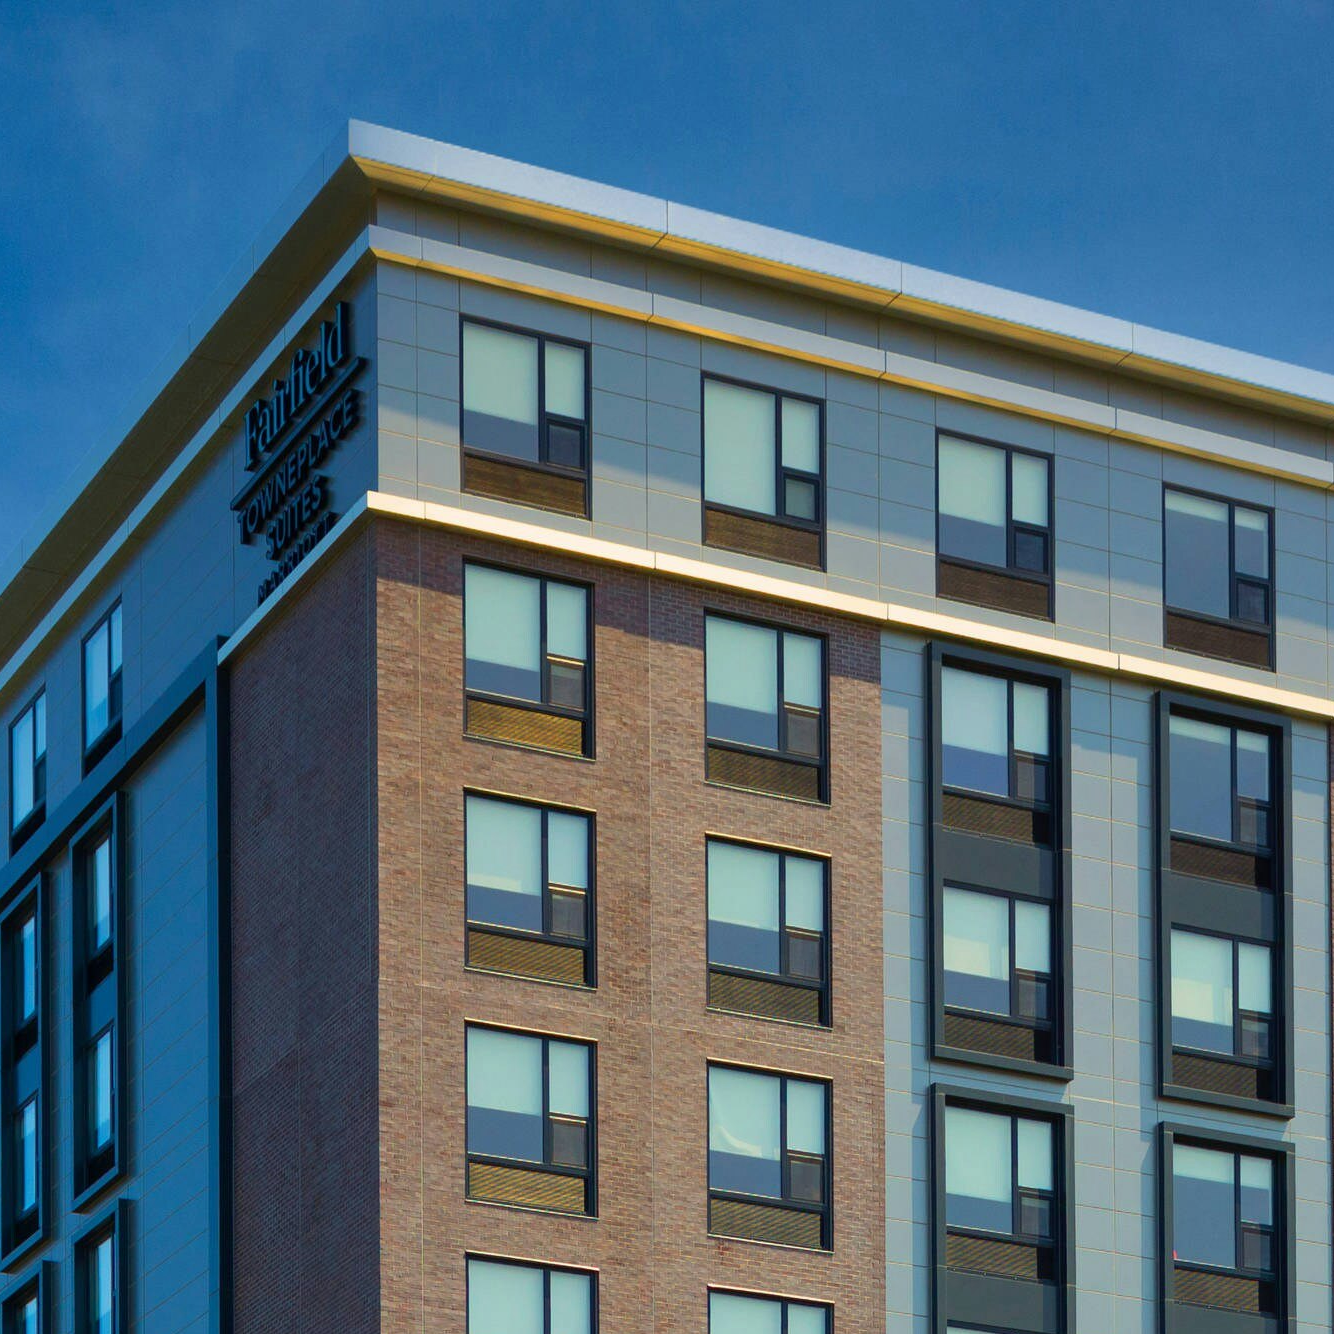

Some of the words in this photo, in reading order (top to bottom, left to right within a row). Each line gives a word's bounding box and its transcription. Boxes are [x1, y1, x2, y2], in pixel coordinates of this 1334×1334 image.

[244, 301, 349, 472] Fairfield
[236, 388, 362, 545] TOWNEPLACE
[266, 475, 327, 560] SUITES
